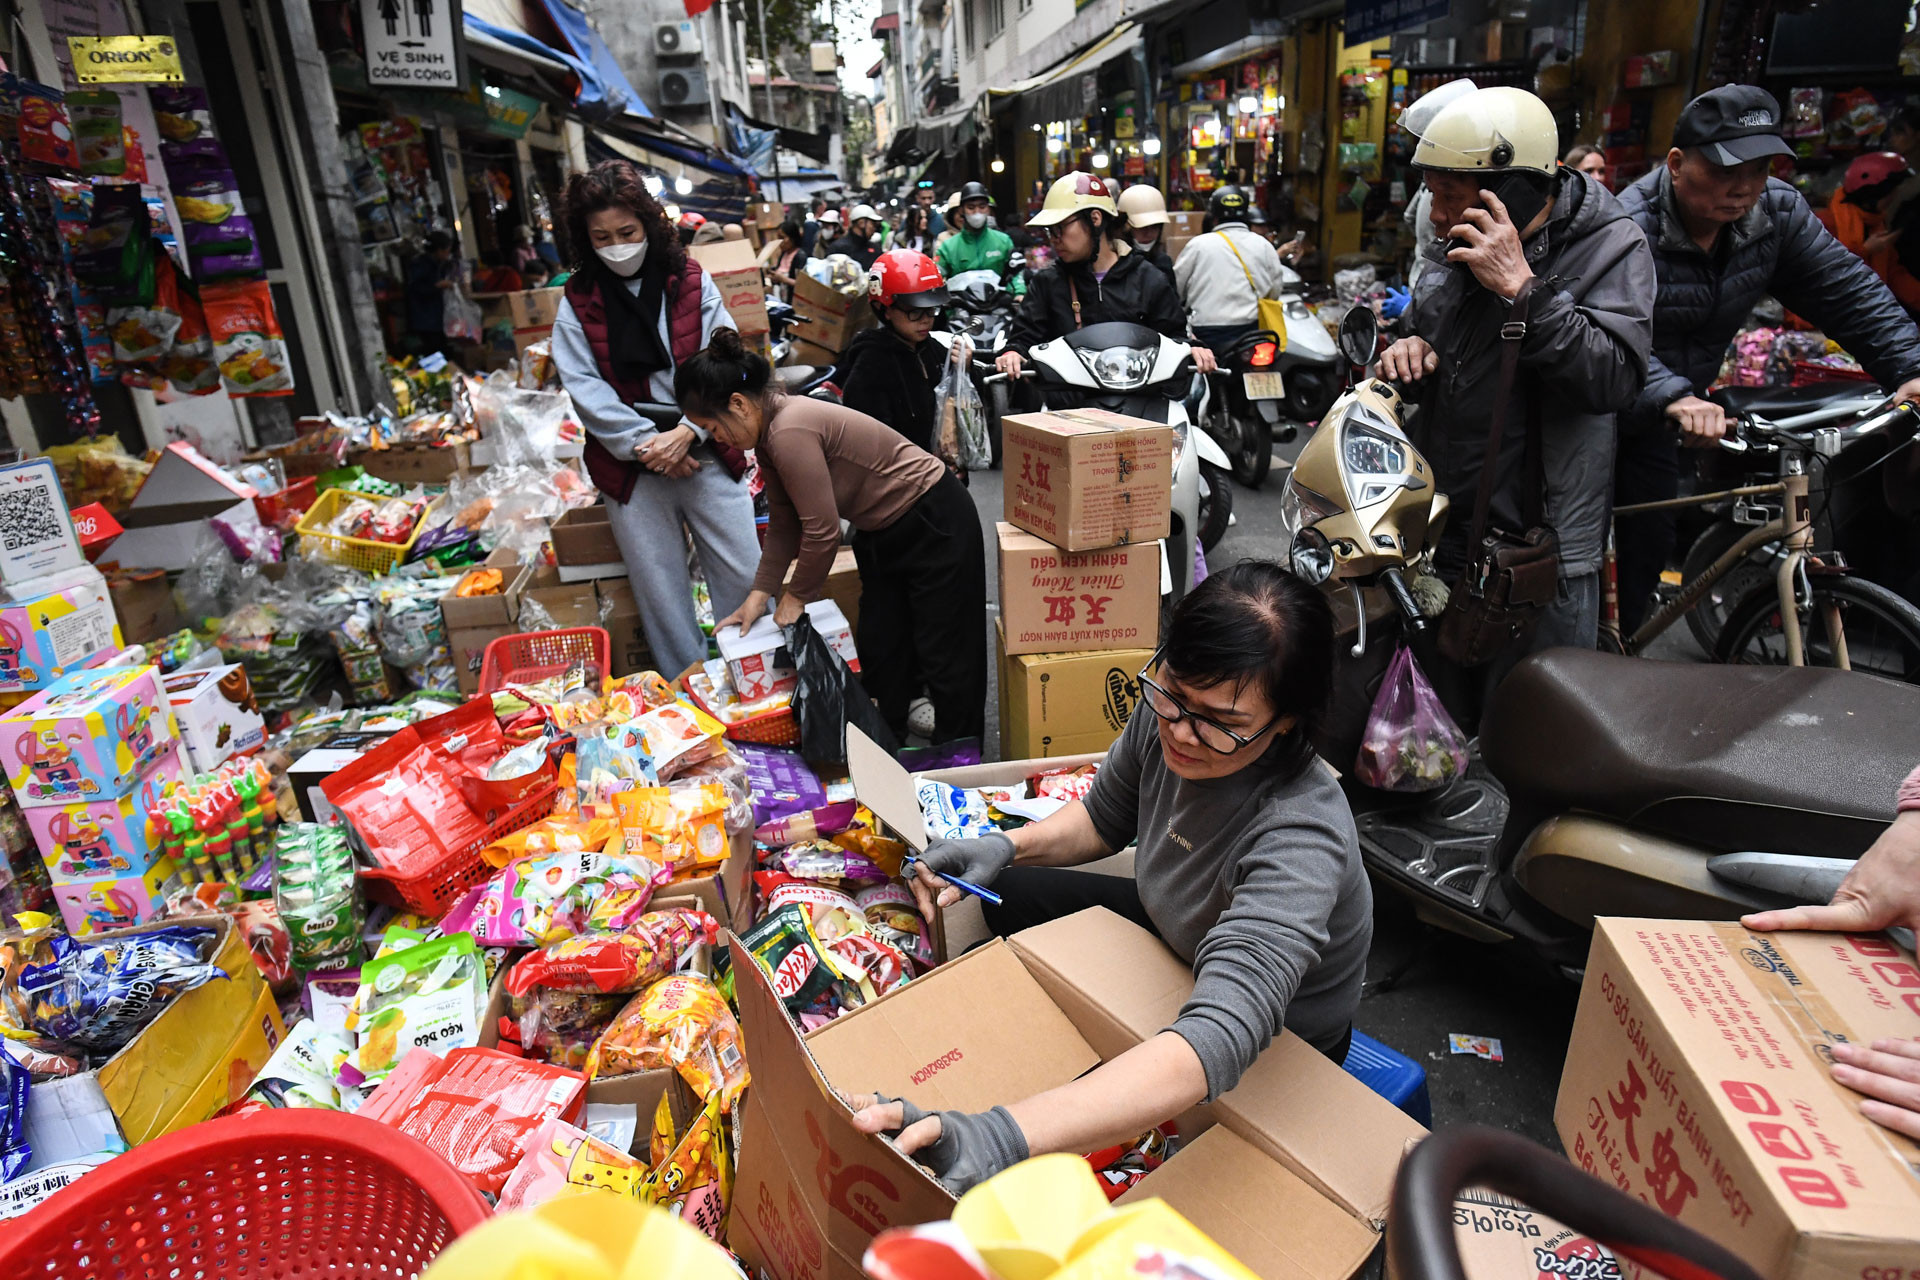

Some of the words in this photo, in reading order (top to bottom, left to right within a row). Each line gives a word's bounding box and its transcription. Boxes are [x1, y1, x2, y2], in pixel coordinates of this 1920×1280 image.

[89, 50, 152, 64] ORION
[377, 52, 400, 64] VỆ
[405, 52, 444, 63] SINH
[372, 65, 411, 79] CÔNG
[414, 68, 452, 81] CỘNG
[1061, 556, 1088, 567] KEM
[1092, 554, 1128, 568] BÁNH
[1019, 631, 1043, 643] NGỌT
[1045, 631, 1067, 643] BÁNH
[1069, 630, 1091, 644] XUẤT
[1093, 629, 1110, 642] SẢN
[1124, 628, 1137, 638] CƠ
[1688, 935, 1704, 948] Lưu
[440, 1021, 464, 1038] KẸO
[1601, 971, 1617, 1003] CƠ
[1613, 997, 1630, 1026] SỞ
[1626, 1017, 1648, 1061] SẢN
[1647, 1051, 1679, 1107] XUẤT
[1676, 1100, 1713, 1165] BÁNH
[1712, 1156, 1753, 1228] NGỌT
